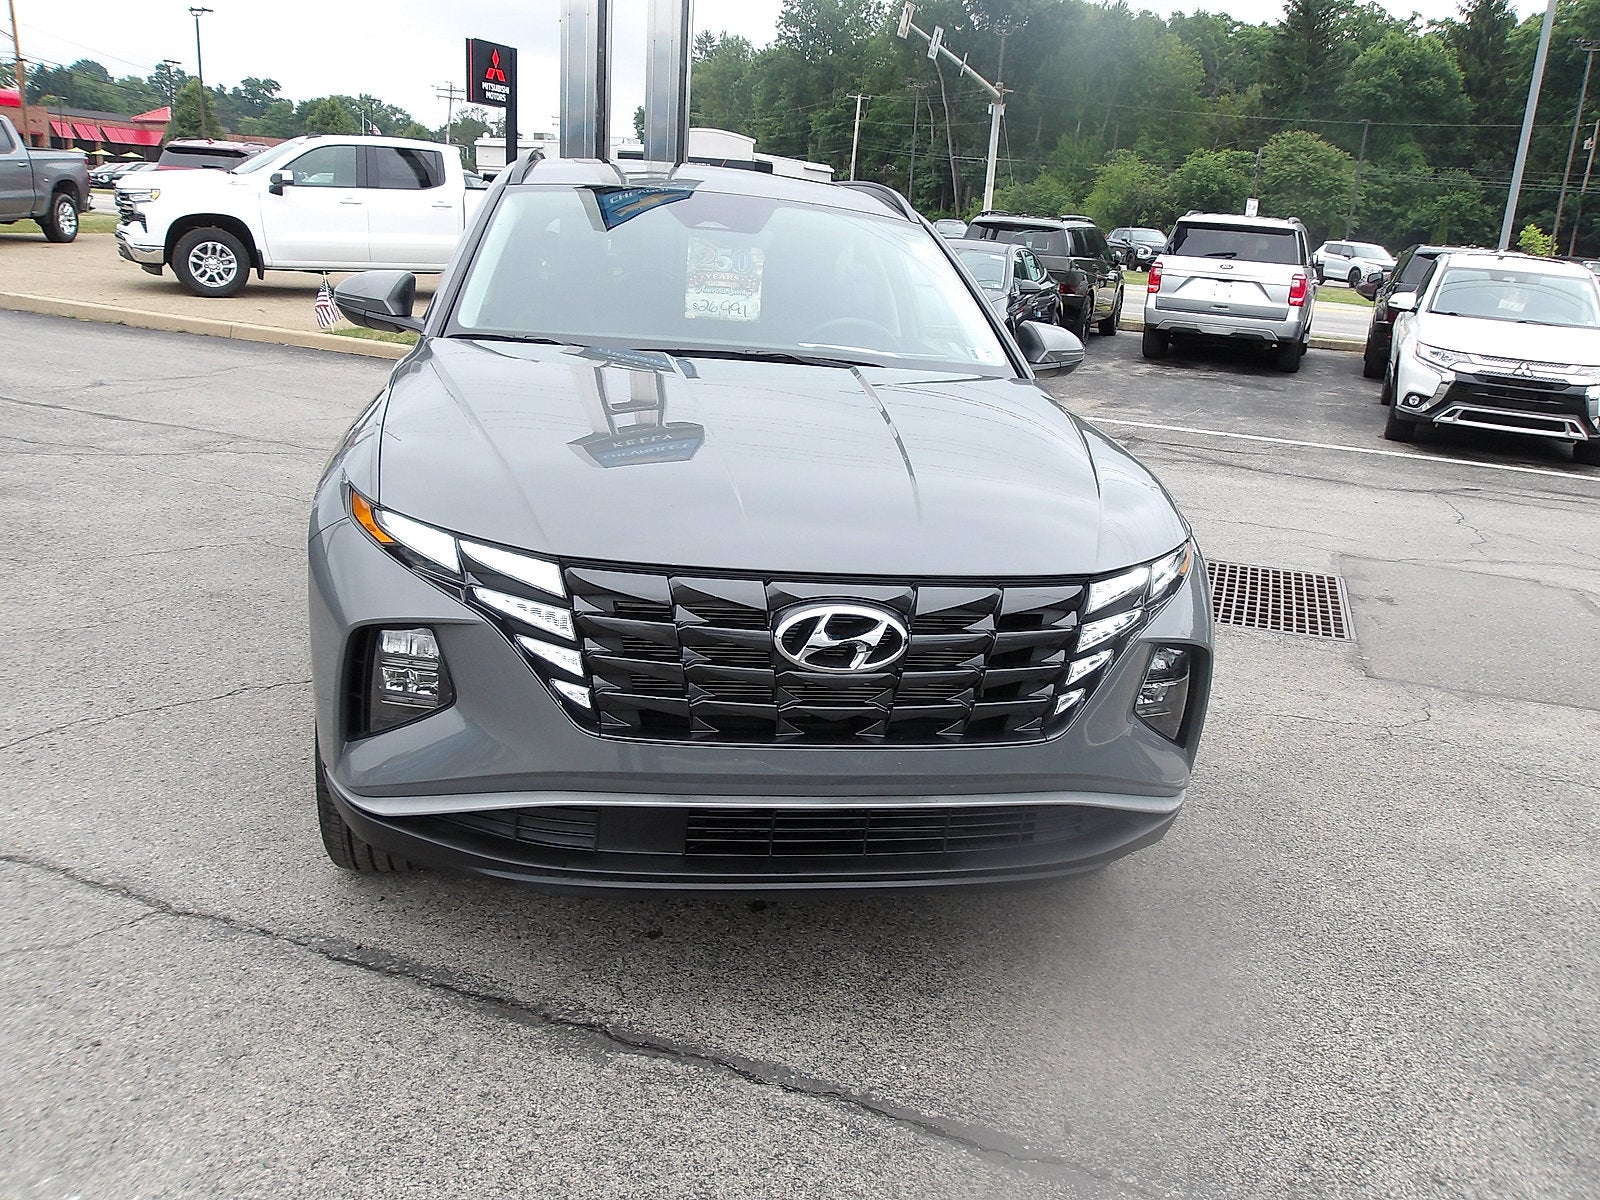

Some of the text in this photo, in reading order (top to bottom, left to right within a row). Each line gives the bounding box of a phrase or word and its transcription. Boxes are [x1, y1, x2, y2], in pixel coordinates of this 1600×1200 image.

[481, 81, 510, 94] MITSUBISHI
[485, 90, 507, 102] MOTORS
[695, 247, 752, 274] 250
